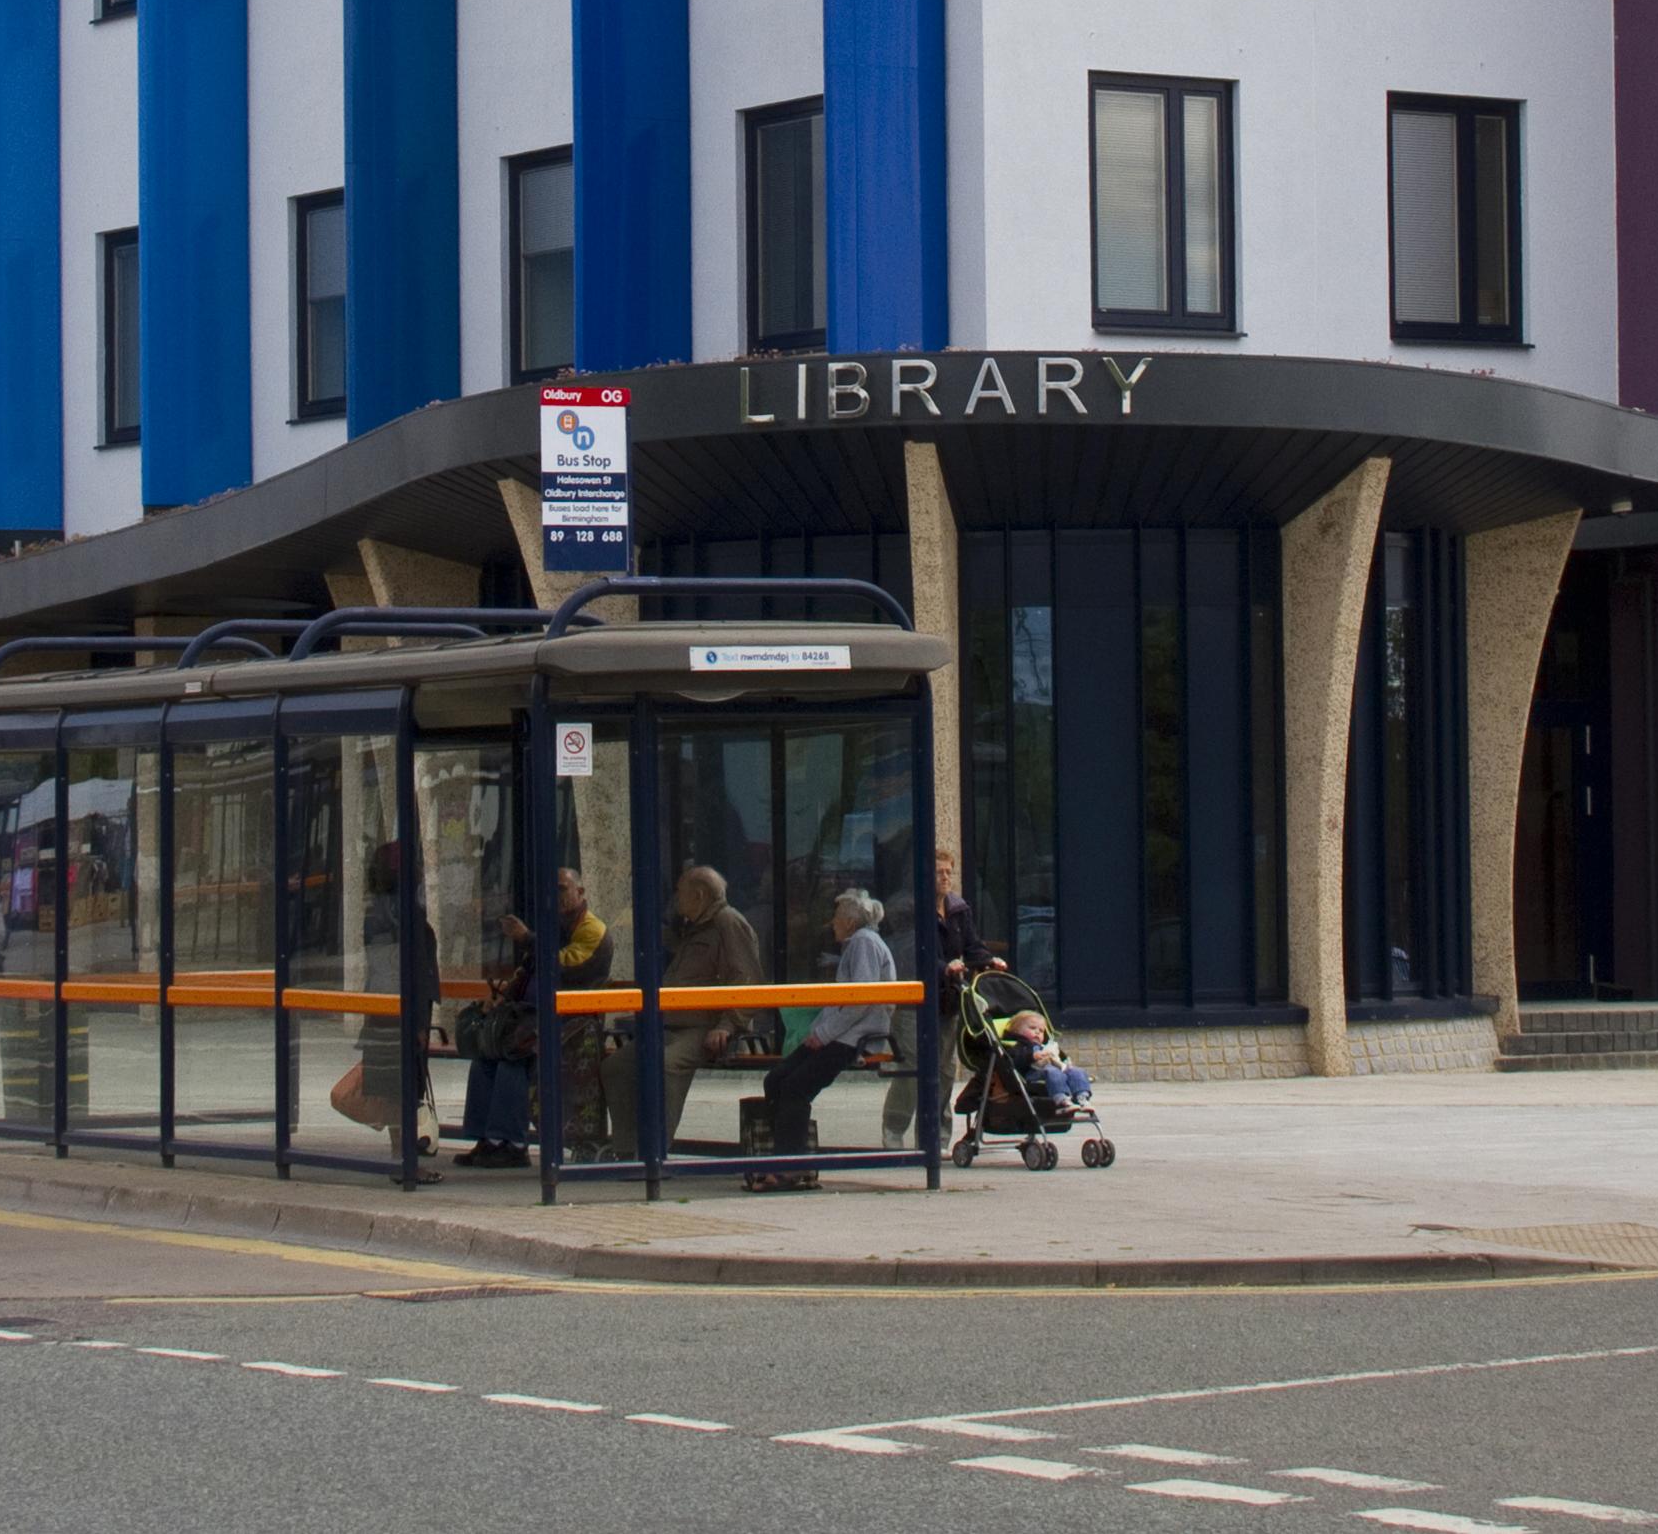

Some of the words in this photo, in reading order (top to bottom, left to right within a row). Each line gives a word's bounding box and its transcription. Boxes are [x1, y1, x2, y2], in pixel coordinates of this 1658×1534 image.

[543, 388, 582, 402] Oldbury
[601, 390, 623, 403] OG
[740, 357, 1153, 423] LIBRARY
[557, 454, 579, 467] Bus
[583, 454, 611, 469] Stop
[556, 475, 602, 484] Halesowen
[603, 475, 612, 484] St
[545, 488, 576, 499] Oldbury
[578, 489, 625, 500] Interchange
[549, 504, 571, 512] Buses
[572, 504, 590, 512] load
[592, 504, 609, 512] here
[611, 504, 622, 512] for
[562, 515, 609, 524] Birmingham
[550, 531, 564, 542] 89
[575, 531, 594, 542] 128
[601, 531, 623, 542] 688
